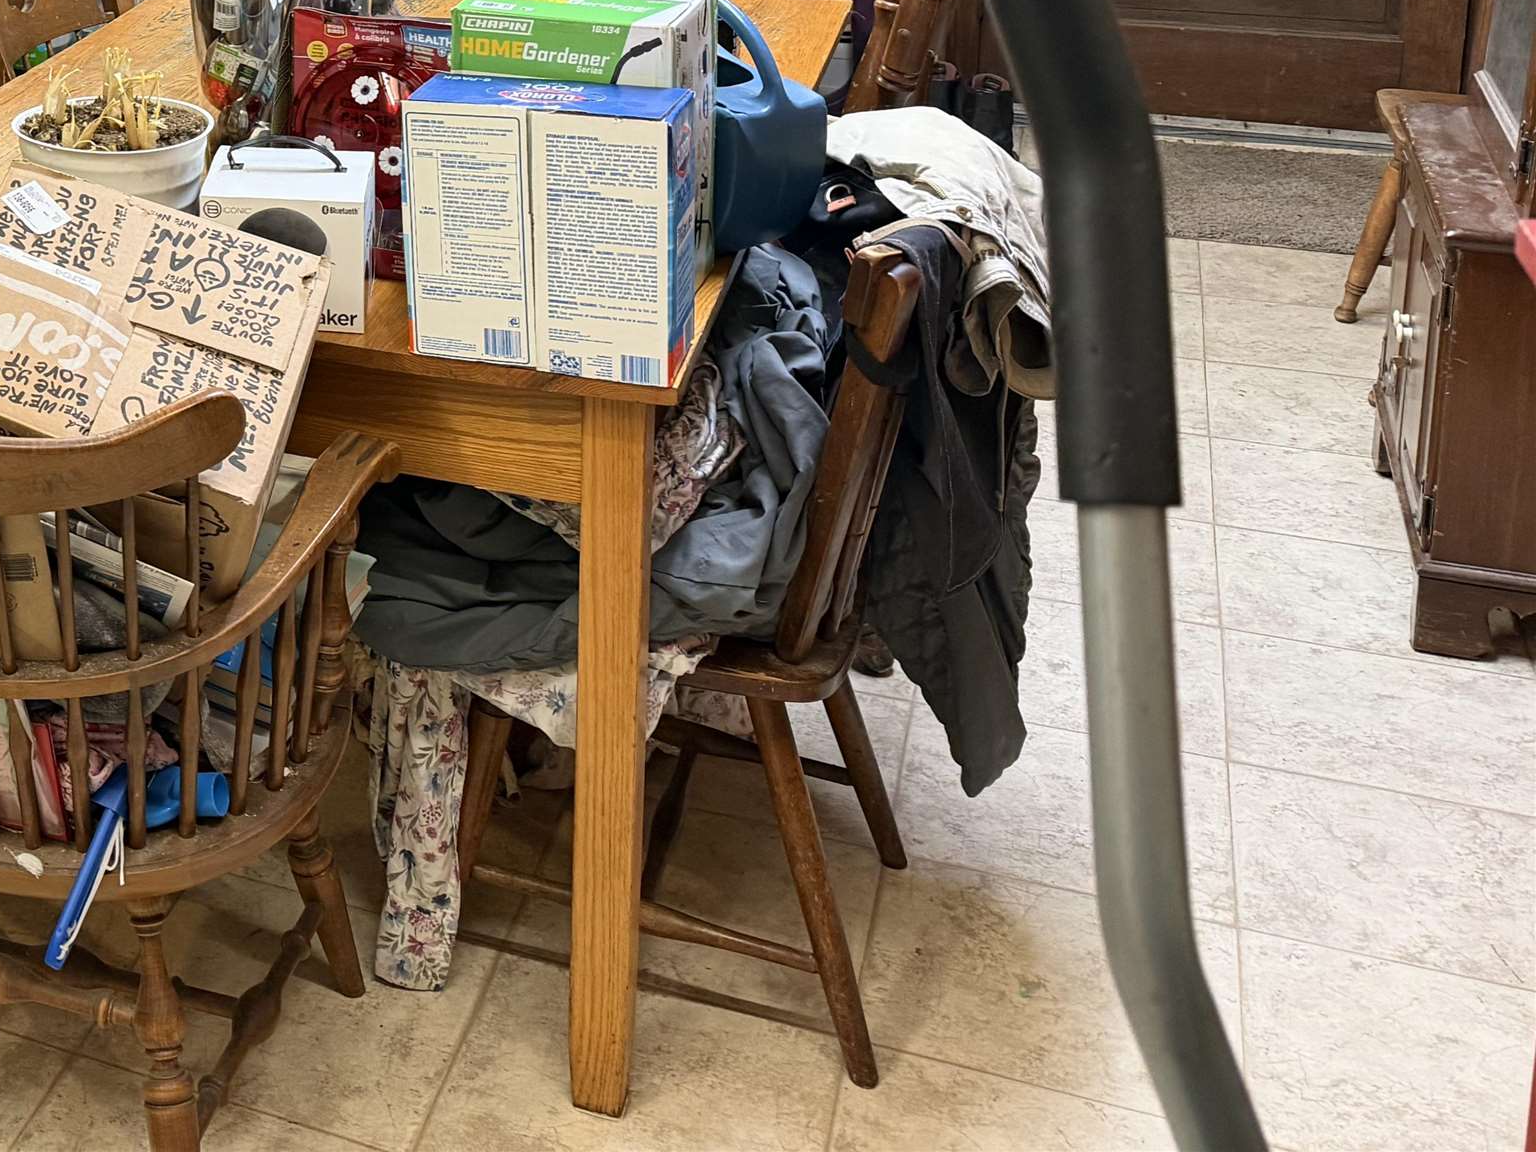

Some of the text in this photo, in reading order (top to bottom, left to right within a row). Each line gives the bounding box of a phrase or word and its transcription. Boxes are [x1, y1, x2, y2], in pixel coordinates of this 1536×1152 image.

[464, 18, 530, 34] CHAPIN
[460, 36, 611, 68] HOMEGardener
[519, 81, 585, 93] POOL
[329, 205, 360, 216] Bluetooth
[233, 273, 295, 297] JUST
[319, 308, 358, 327] aker
